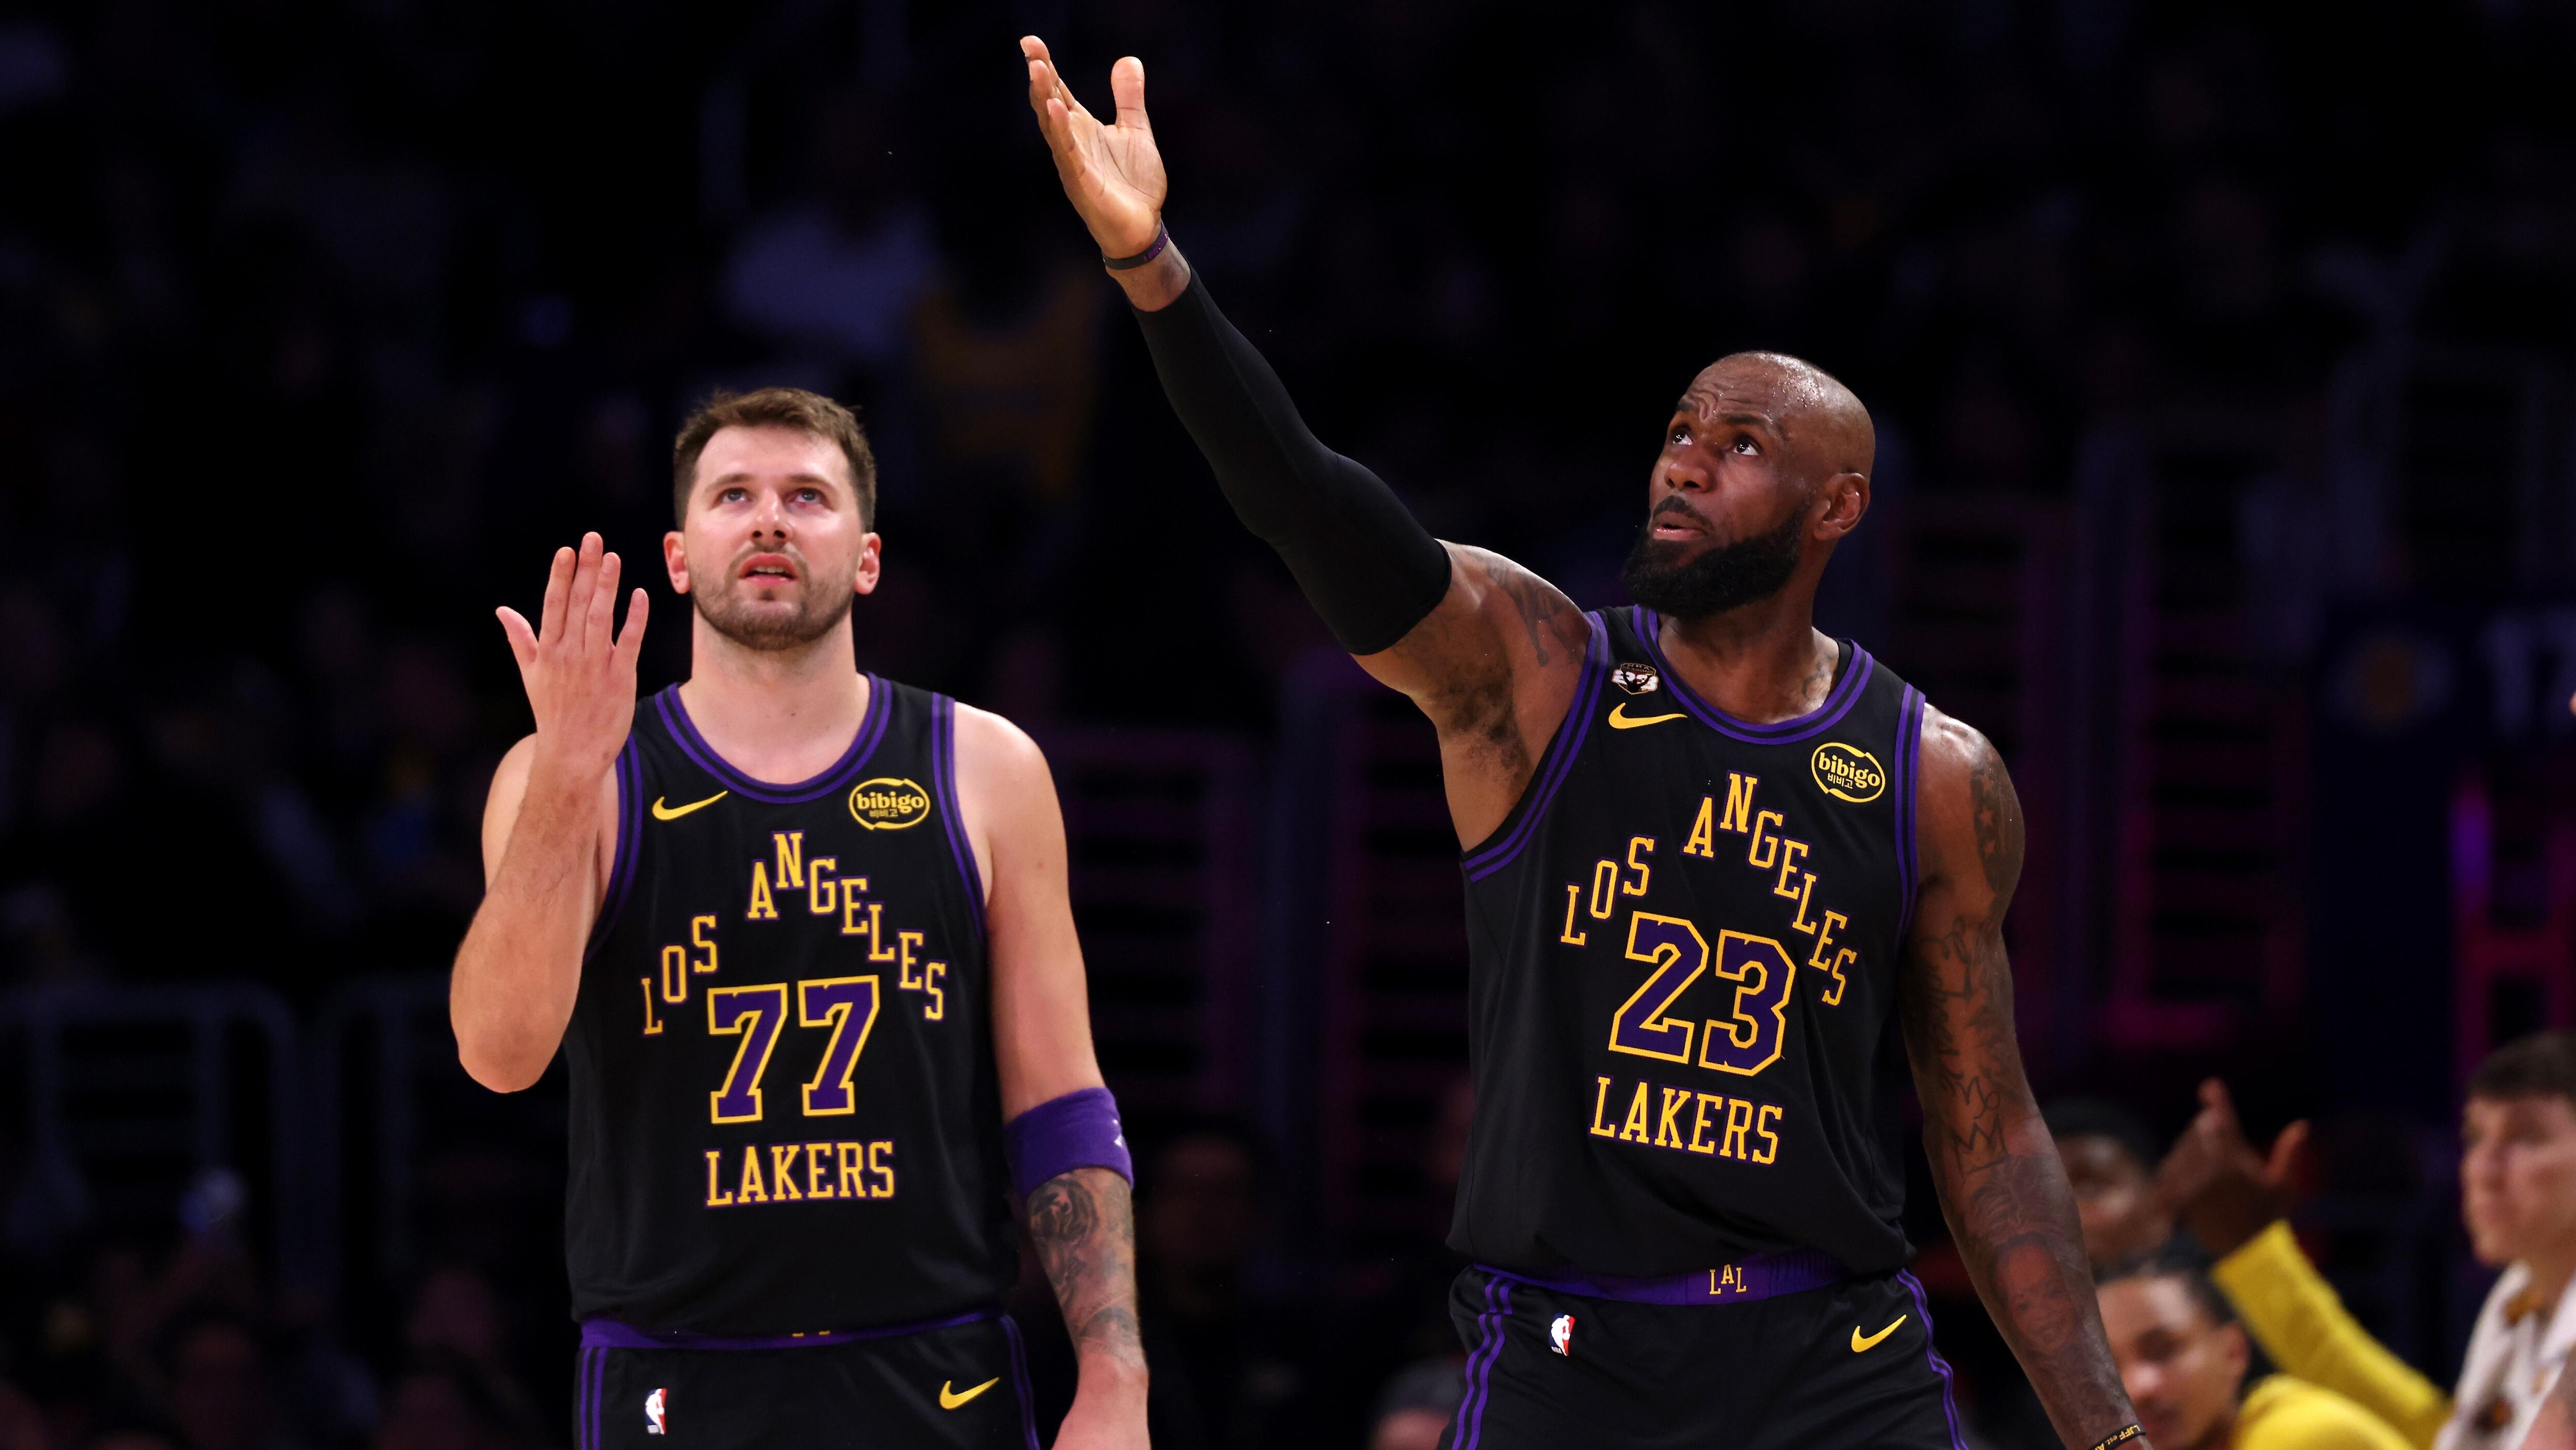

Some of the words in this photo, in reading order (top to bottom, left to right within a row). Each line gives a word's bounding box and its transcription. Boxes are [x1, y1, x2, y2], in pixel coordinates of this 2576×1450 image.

[856, 790, 925, 814] bibigo
[1818, 752, 1881, 789] bibigo
[1827, 772, 1853, 789] 비비고
[1559, 835, 1656, 948] LOS
[1682, 771, 1859, 1007] ANGELES
[639, 914, 719, 1036] LOS
[745, 831, 947, 1022] ANGELES
[1607, 910, 1797, 1077] 23
[706, 974, 881, 1125] 77
[1588, 1075, 1784, 1166] LAKERS
[704, 1139, 896, 1208] LAKERS
[1708, 1263, 1748, 1295] LAL
